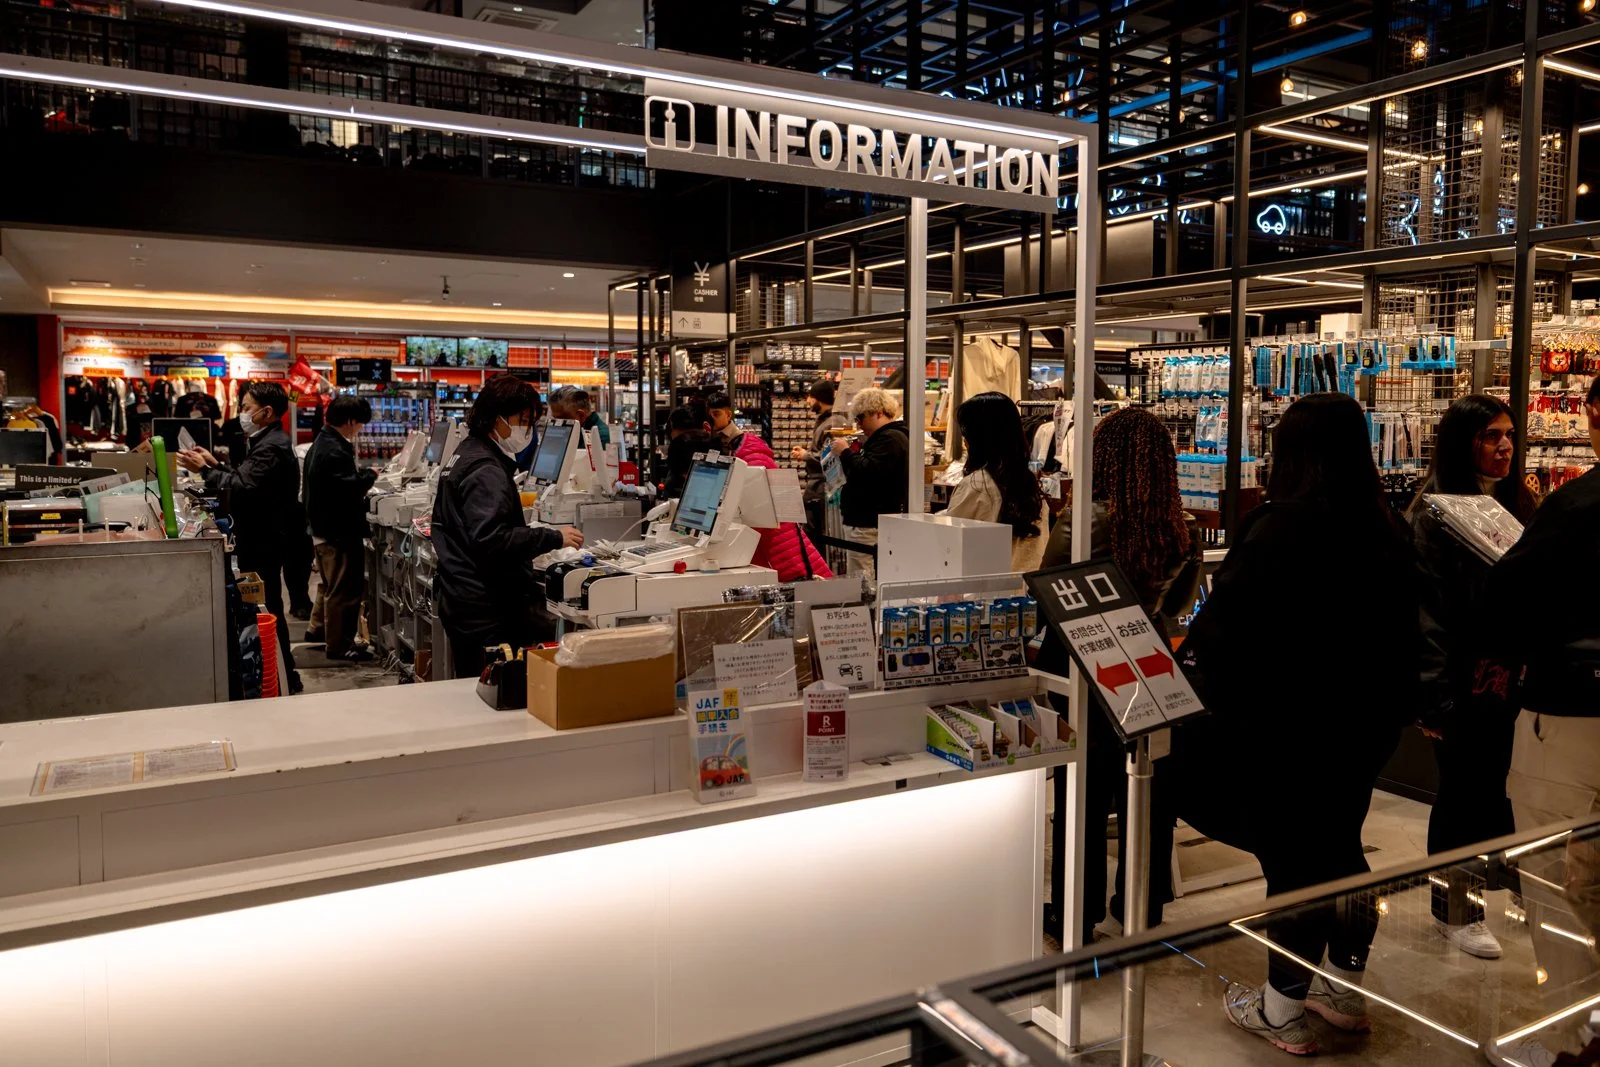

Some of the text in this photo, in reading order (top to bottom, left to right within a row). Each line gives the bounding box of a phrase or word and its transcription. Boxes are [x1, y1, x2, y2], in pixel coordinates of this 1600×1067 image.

[716, 104, 1059, 198] INFORMATION
[693, 288, 718, 297] CASHIER
[194, 341, 217, 349] JDM
[20, 475, 35, 483] This
[35, 475, 42, 483] is
[48, 476, 72, 484] limited
[1051, 572, 1121, 611] 出口
[1068, 623, 1106, 640] お問合せ
[1116, 619, 1151, 637] お会計
[1078, 637, 1116, 656] 作業依頼
[696, 697, 720, 709] JAF
[822, 714, 832, 727] R
[817, 726, 836, 734] POINT
[726, 774, 745, 785] JAF
